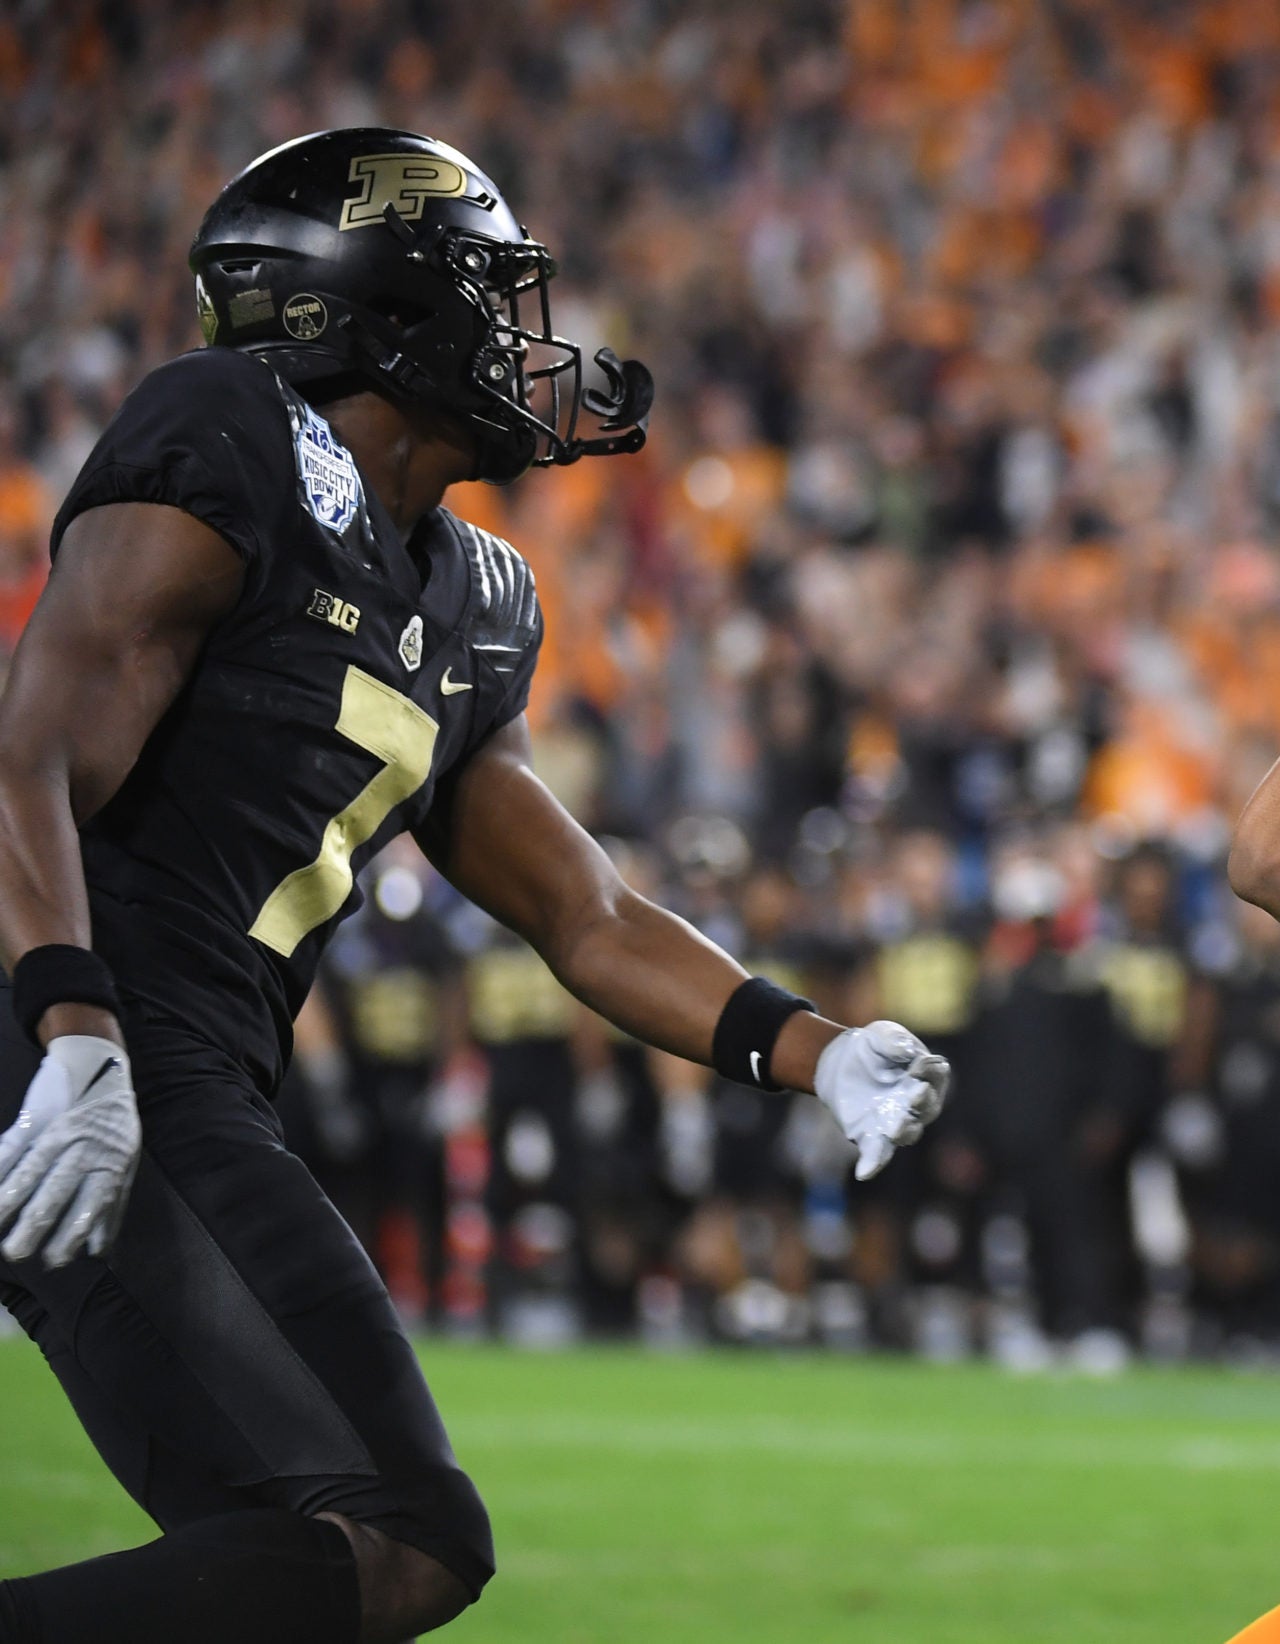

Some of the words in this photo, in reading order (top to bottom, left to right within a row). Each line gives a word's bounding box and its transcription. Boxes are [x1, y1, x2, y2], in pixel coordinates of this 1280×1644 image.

[339, 153, 468, 231] P
[286, 302, 321, 318] RECTOR
[302, 452, 328, 481] MUSIC
[329, 469, 353, 496] CITY
[313, 477, 342, 504] BOWL
[247, 664, 440, 959] 7
